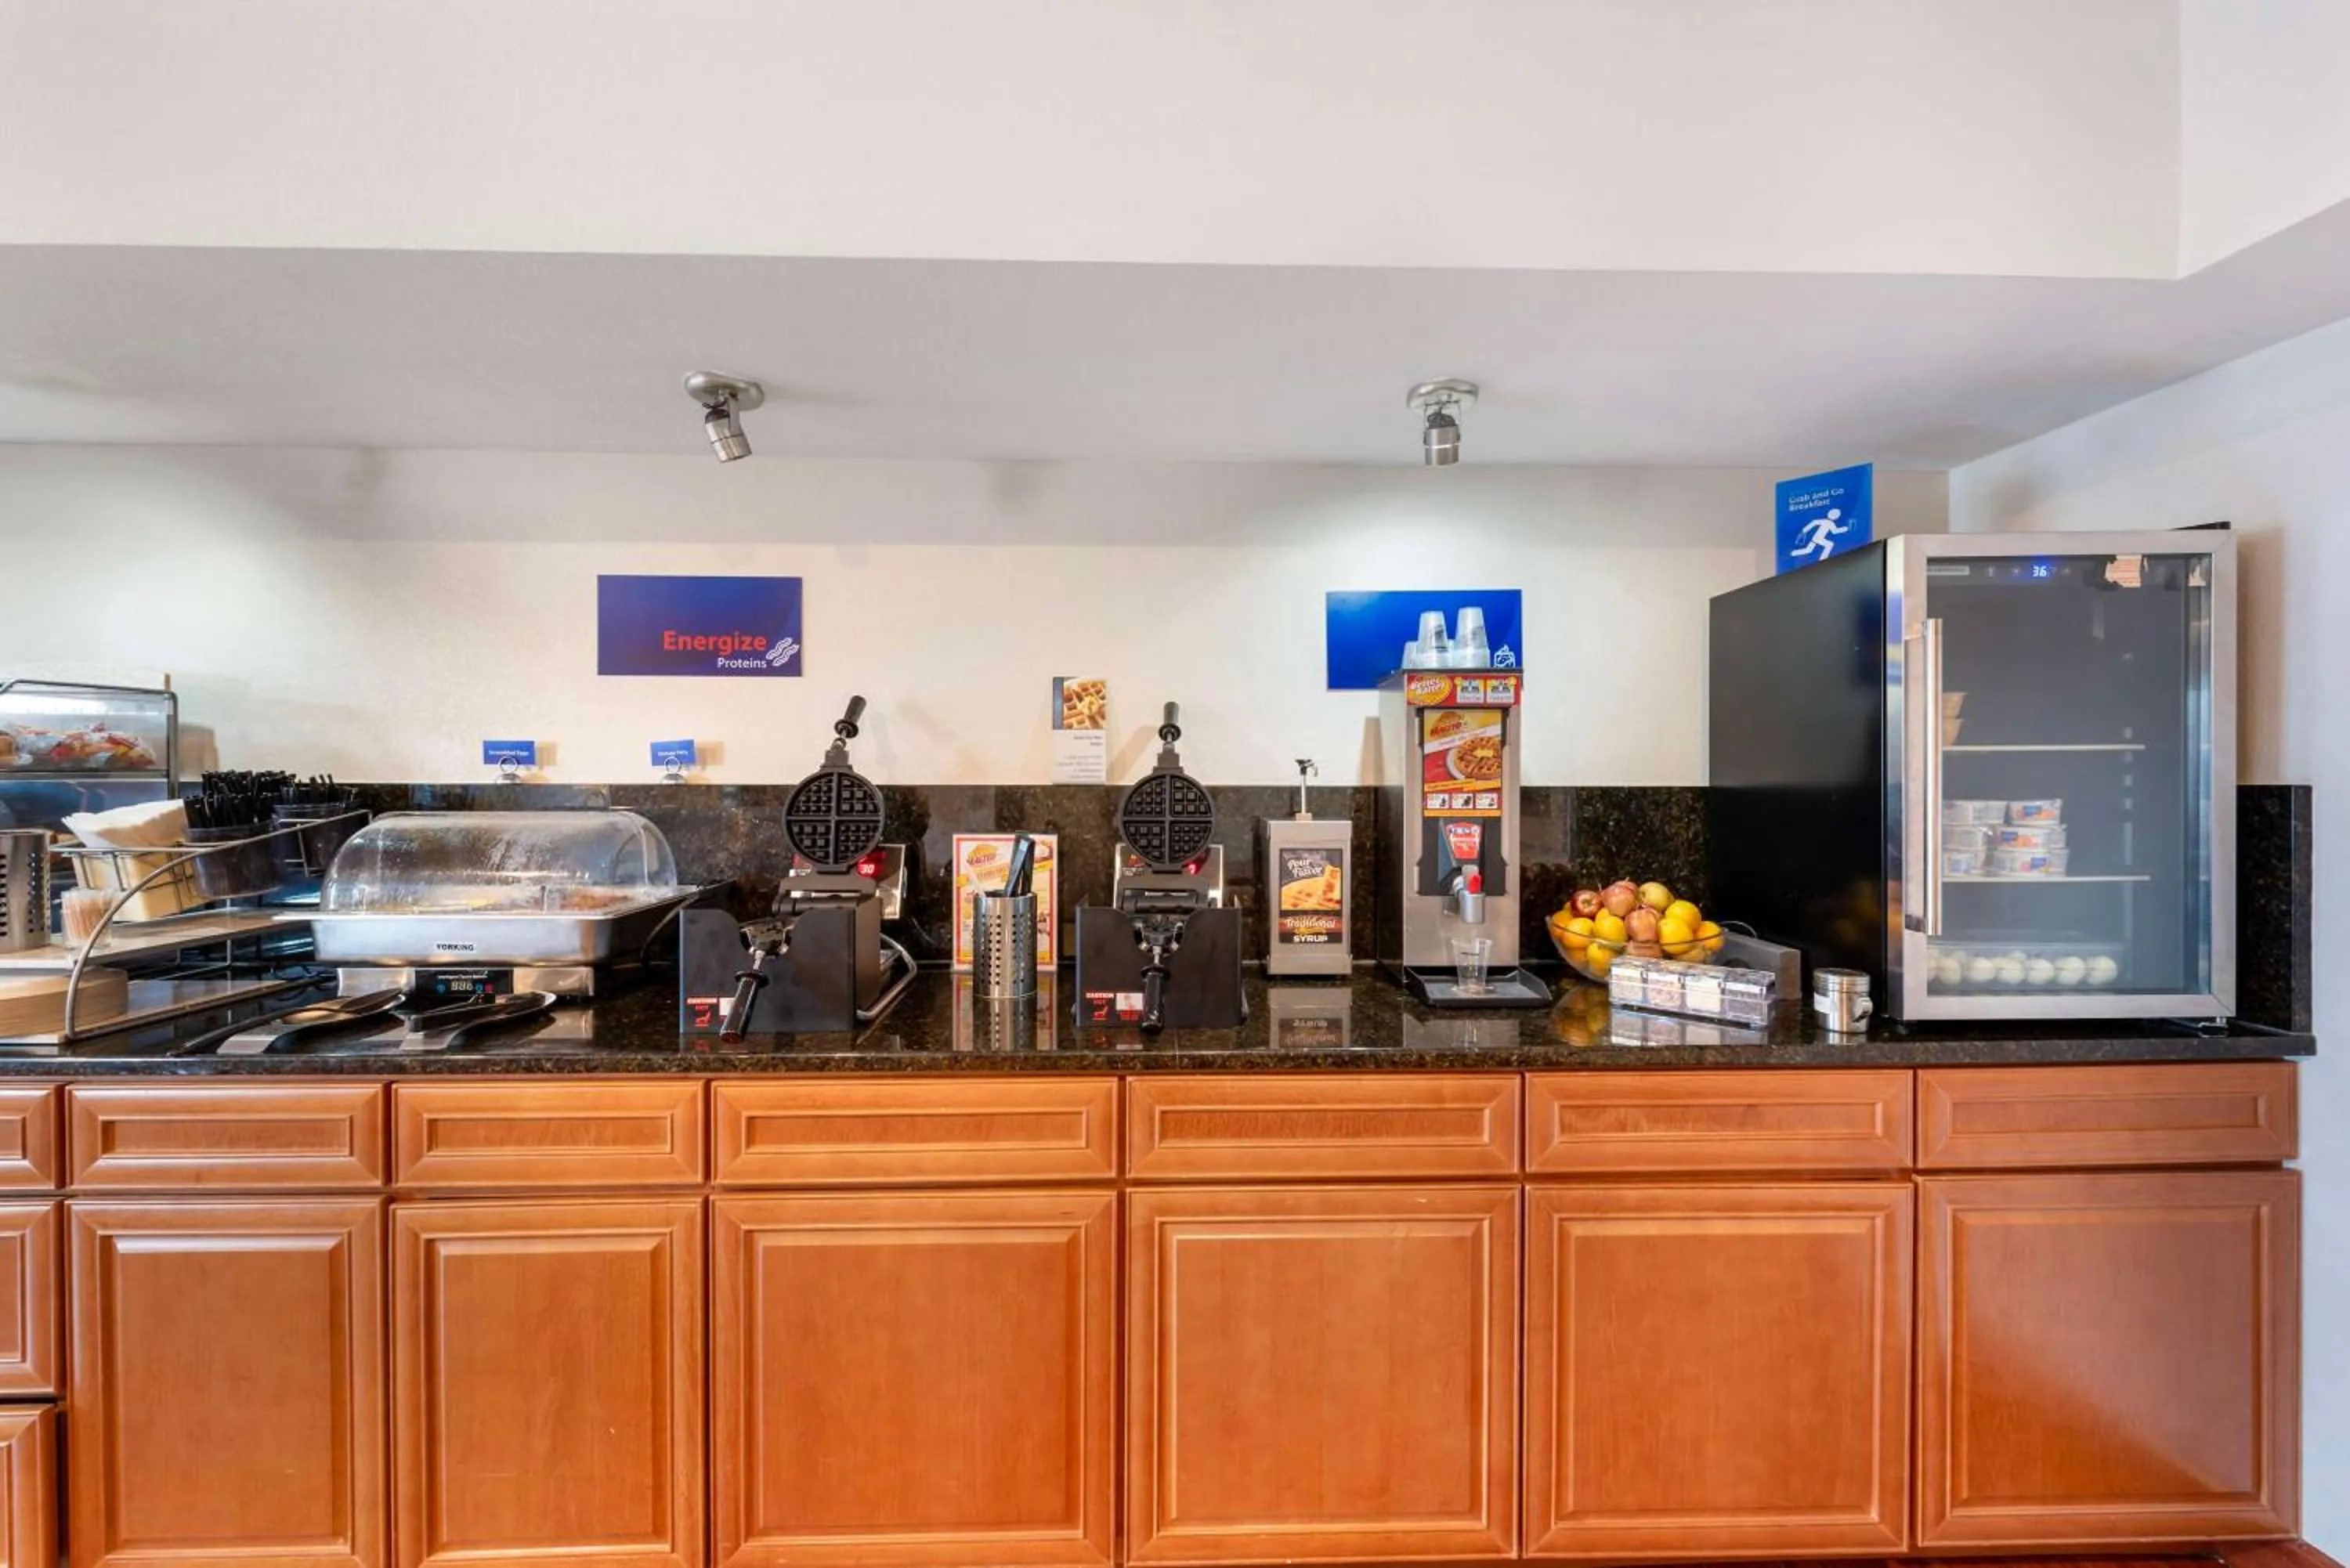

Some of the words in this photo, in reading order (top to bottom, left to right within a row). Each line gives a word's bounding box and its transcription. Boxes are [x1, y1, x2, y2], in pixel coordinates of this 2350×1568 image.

[1788, 493, 1810, 504] Grab
[2033, 565, 2047, 577] 36
[663, 630, 767, 656] Energize
[717, 657, 767, 668] Proteins
[1286, 916, 1337, 928] Traditional
